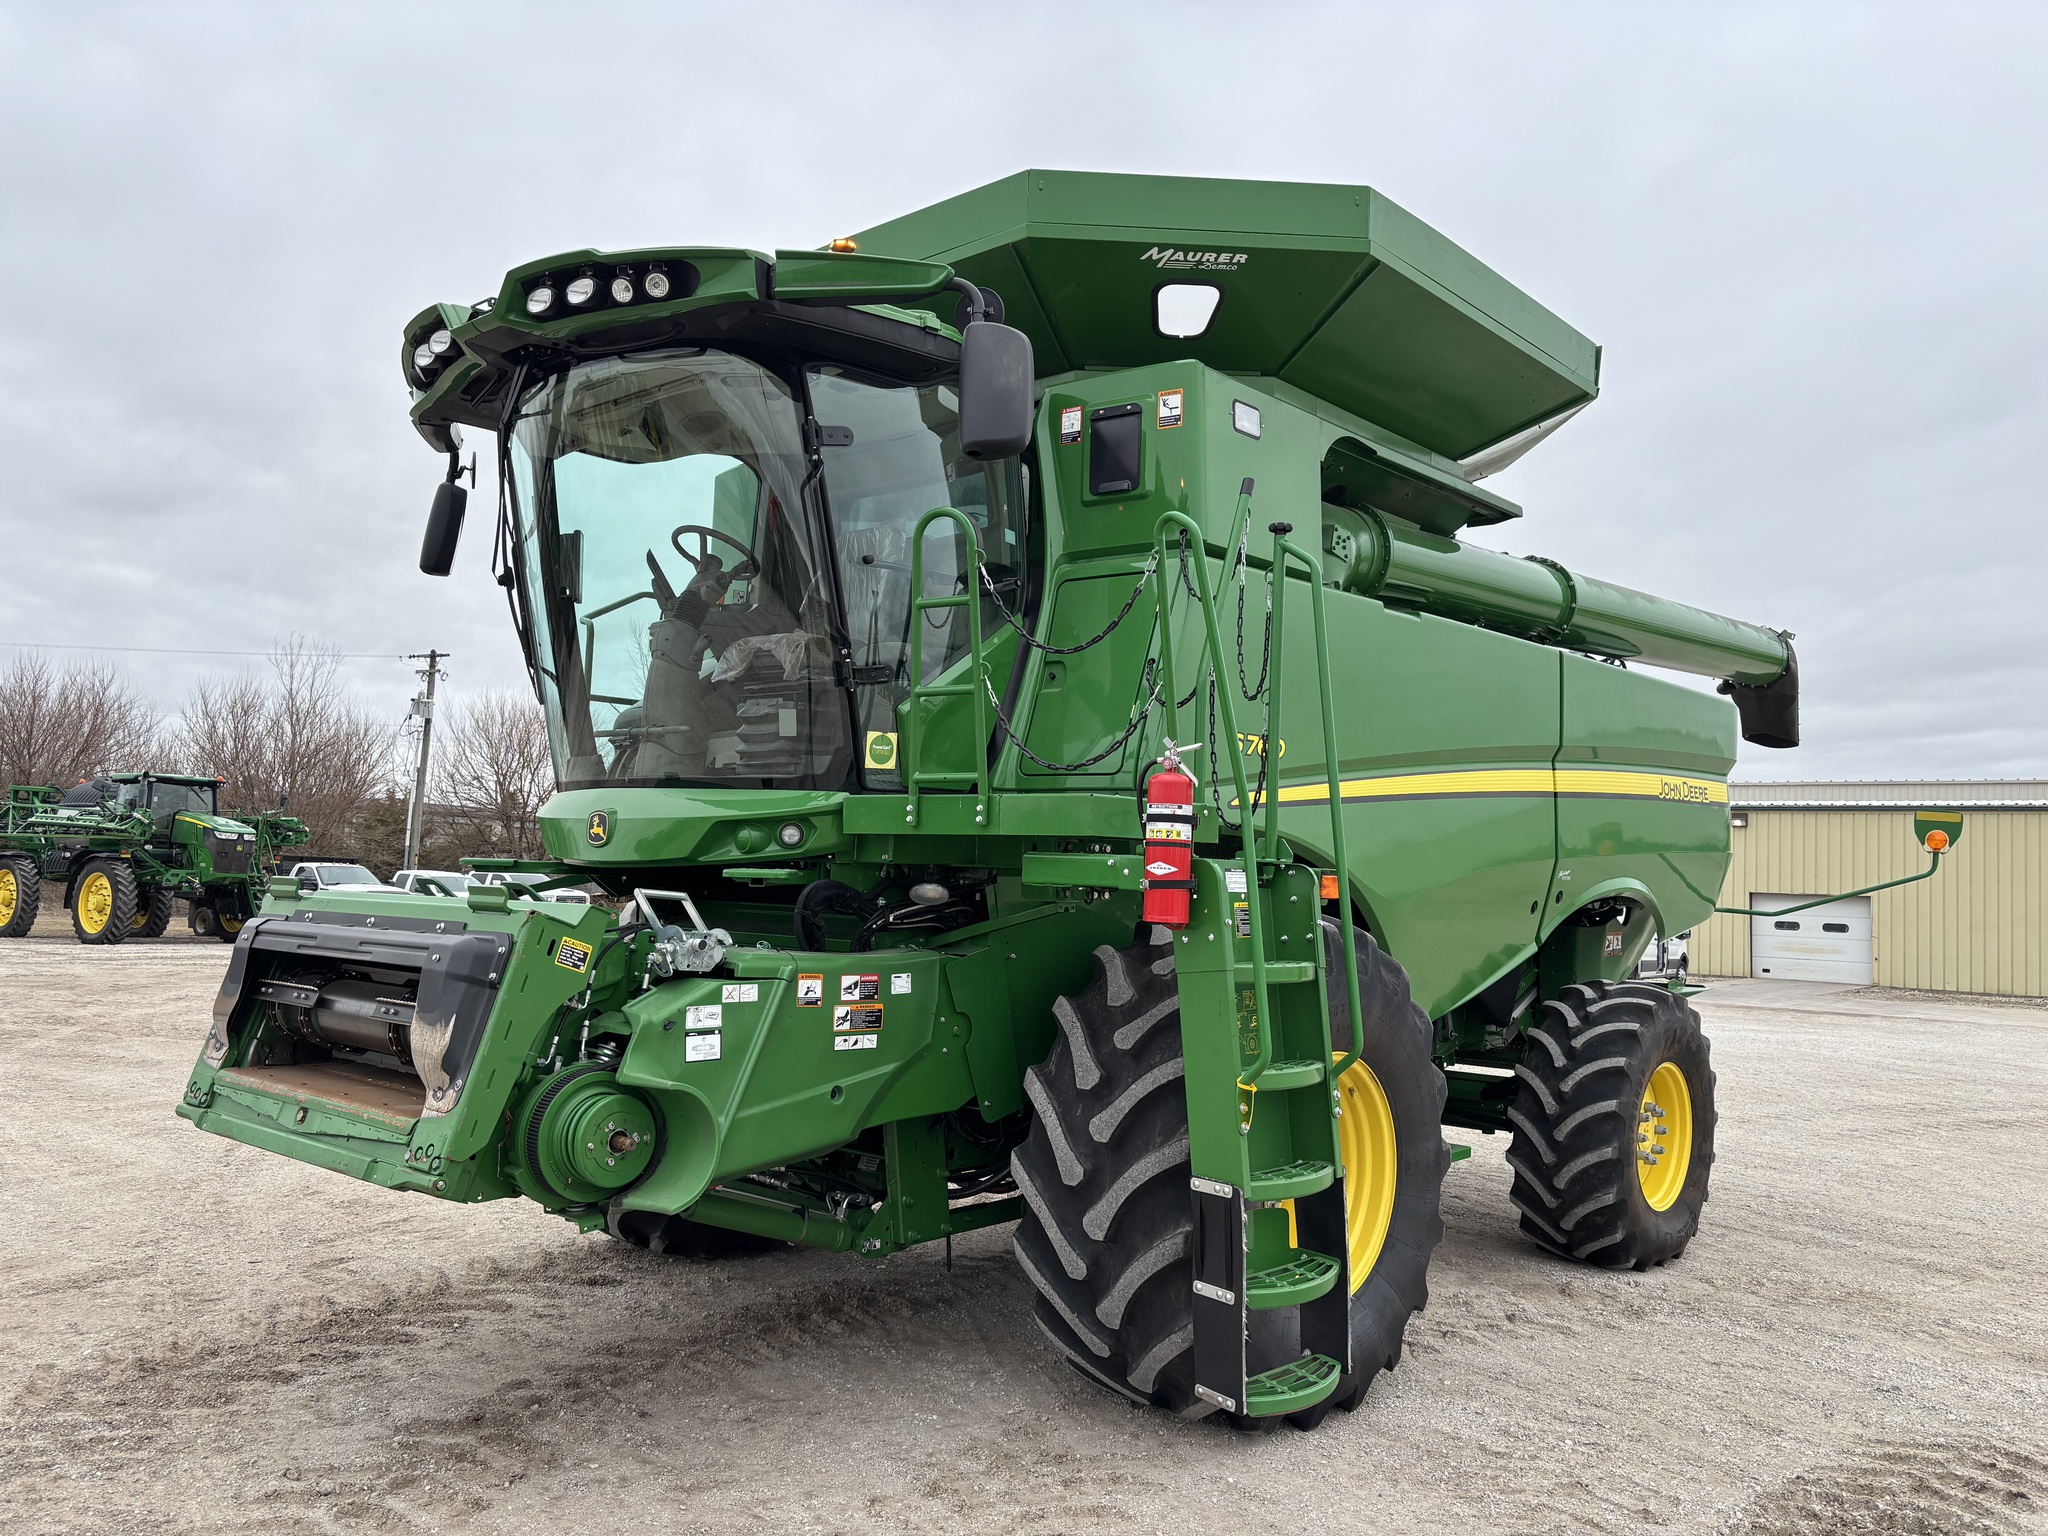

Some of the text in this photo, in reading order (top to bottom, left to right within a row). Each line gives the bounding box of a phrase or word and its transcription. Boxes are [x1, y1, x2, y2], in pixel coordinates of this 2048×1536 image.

[1139, 246, 1248, 268] MAURER
[1199, 262, 1238, 271] Demco
[1659, 778, 1709, 801] JOHN DEERE
[567, 939, 591, 951] CAUTION
